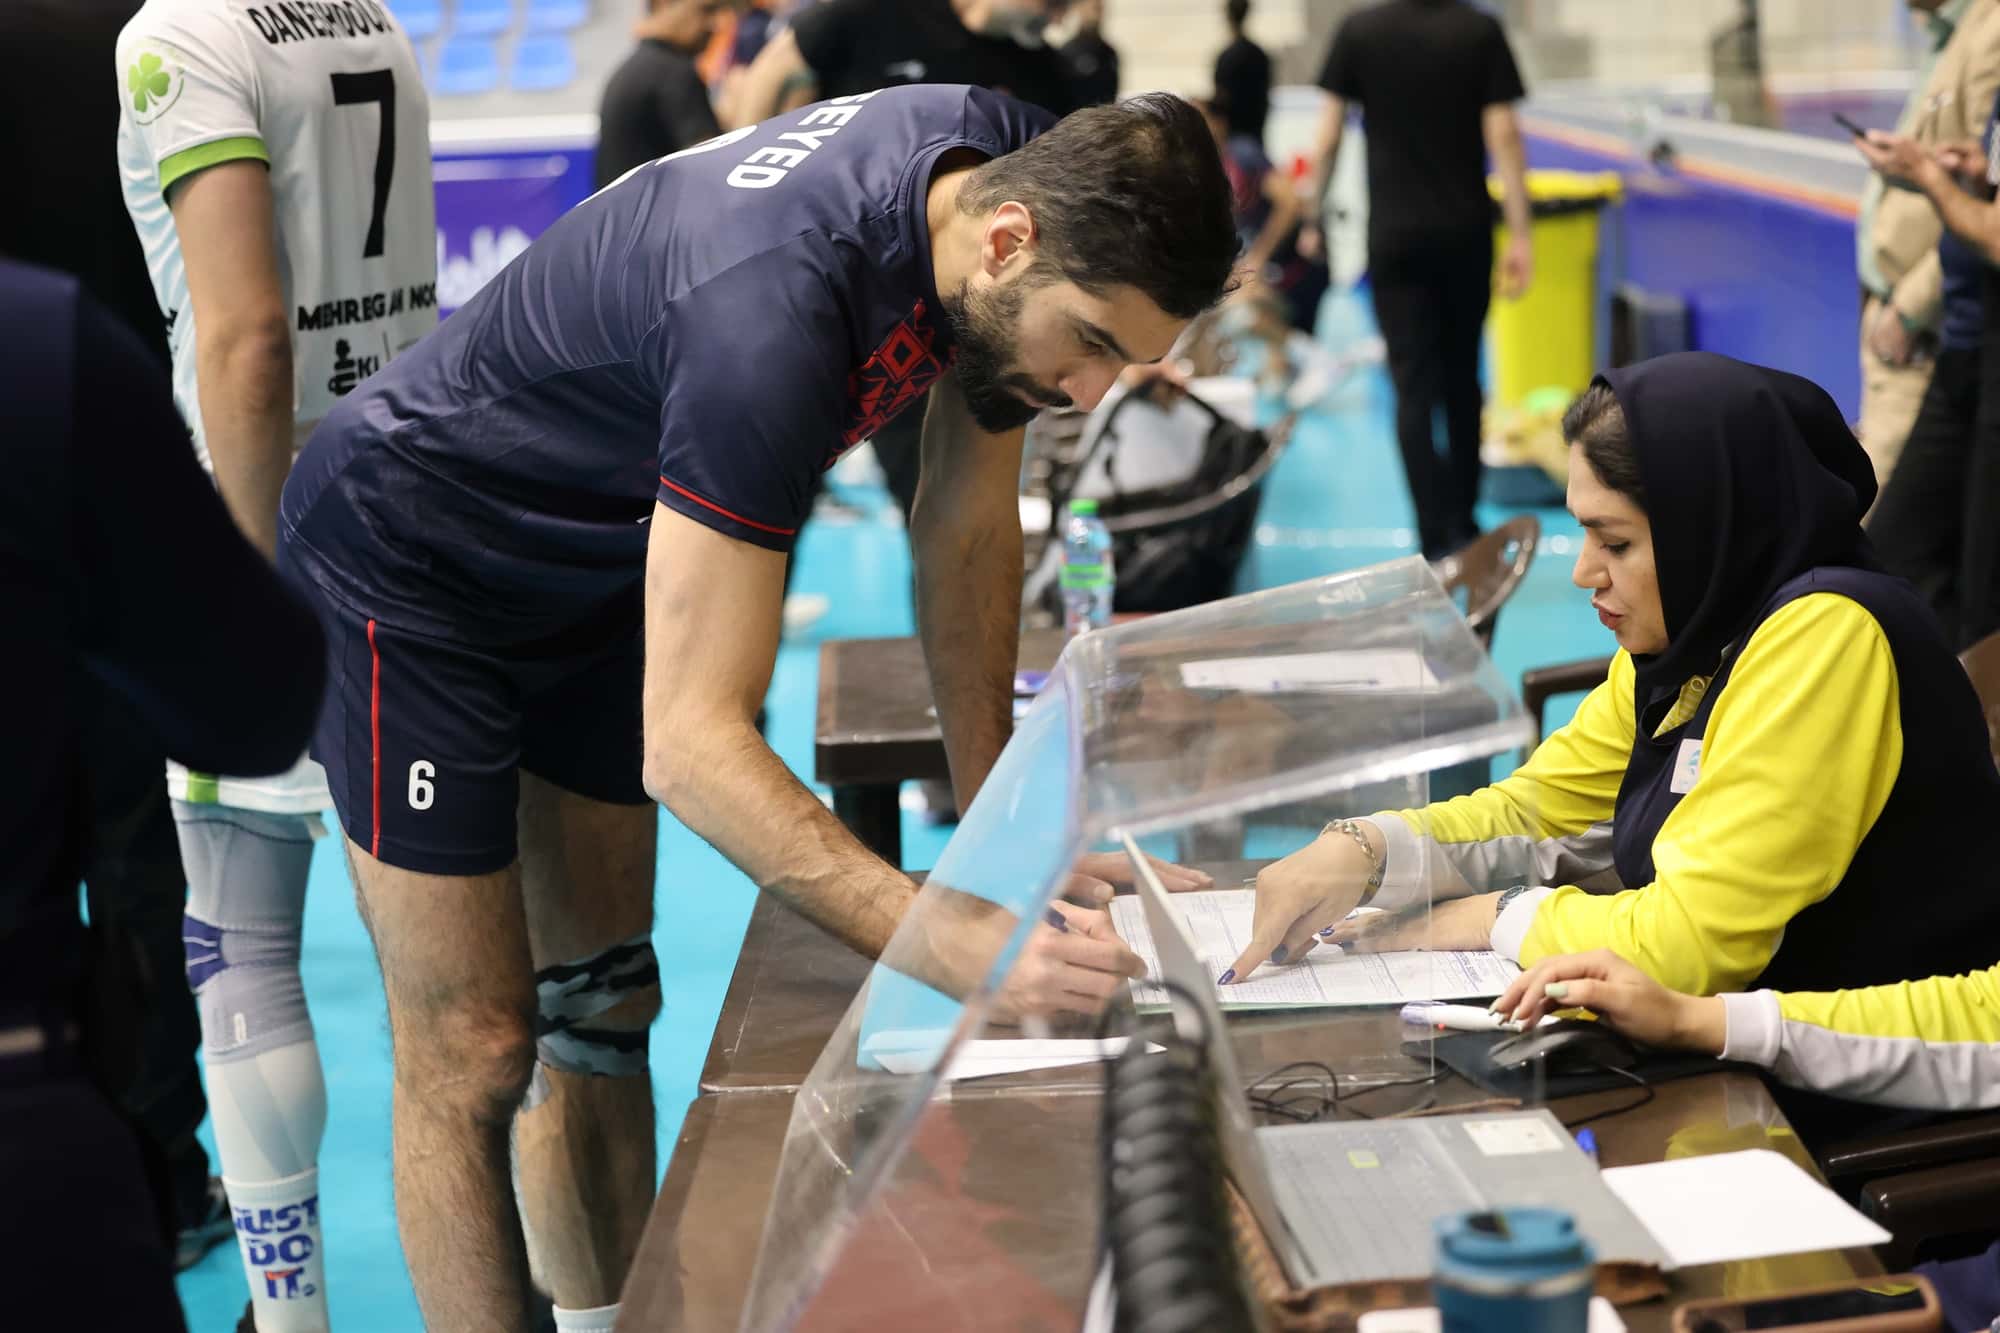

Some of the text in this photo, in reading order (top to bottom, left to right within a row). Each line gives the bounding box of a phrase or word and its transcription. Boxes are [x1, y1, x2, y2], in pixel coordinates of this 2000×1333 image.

[330, 68, 396, 258] 7
[408, 760, 435, 810] 6
[247, 1234, 313, 1266] DO
